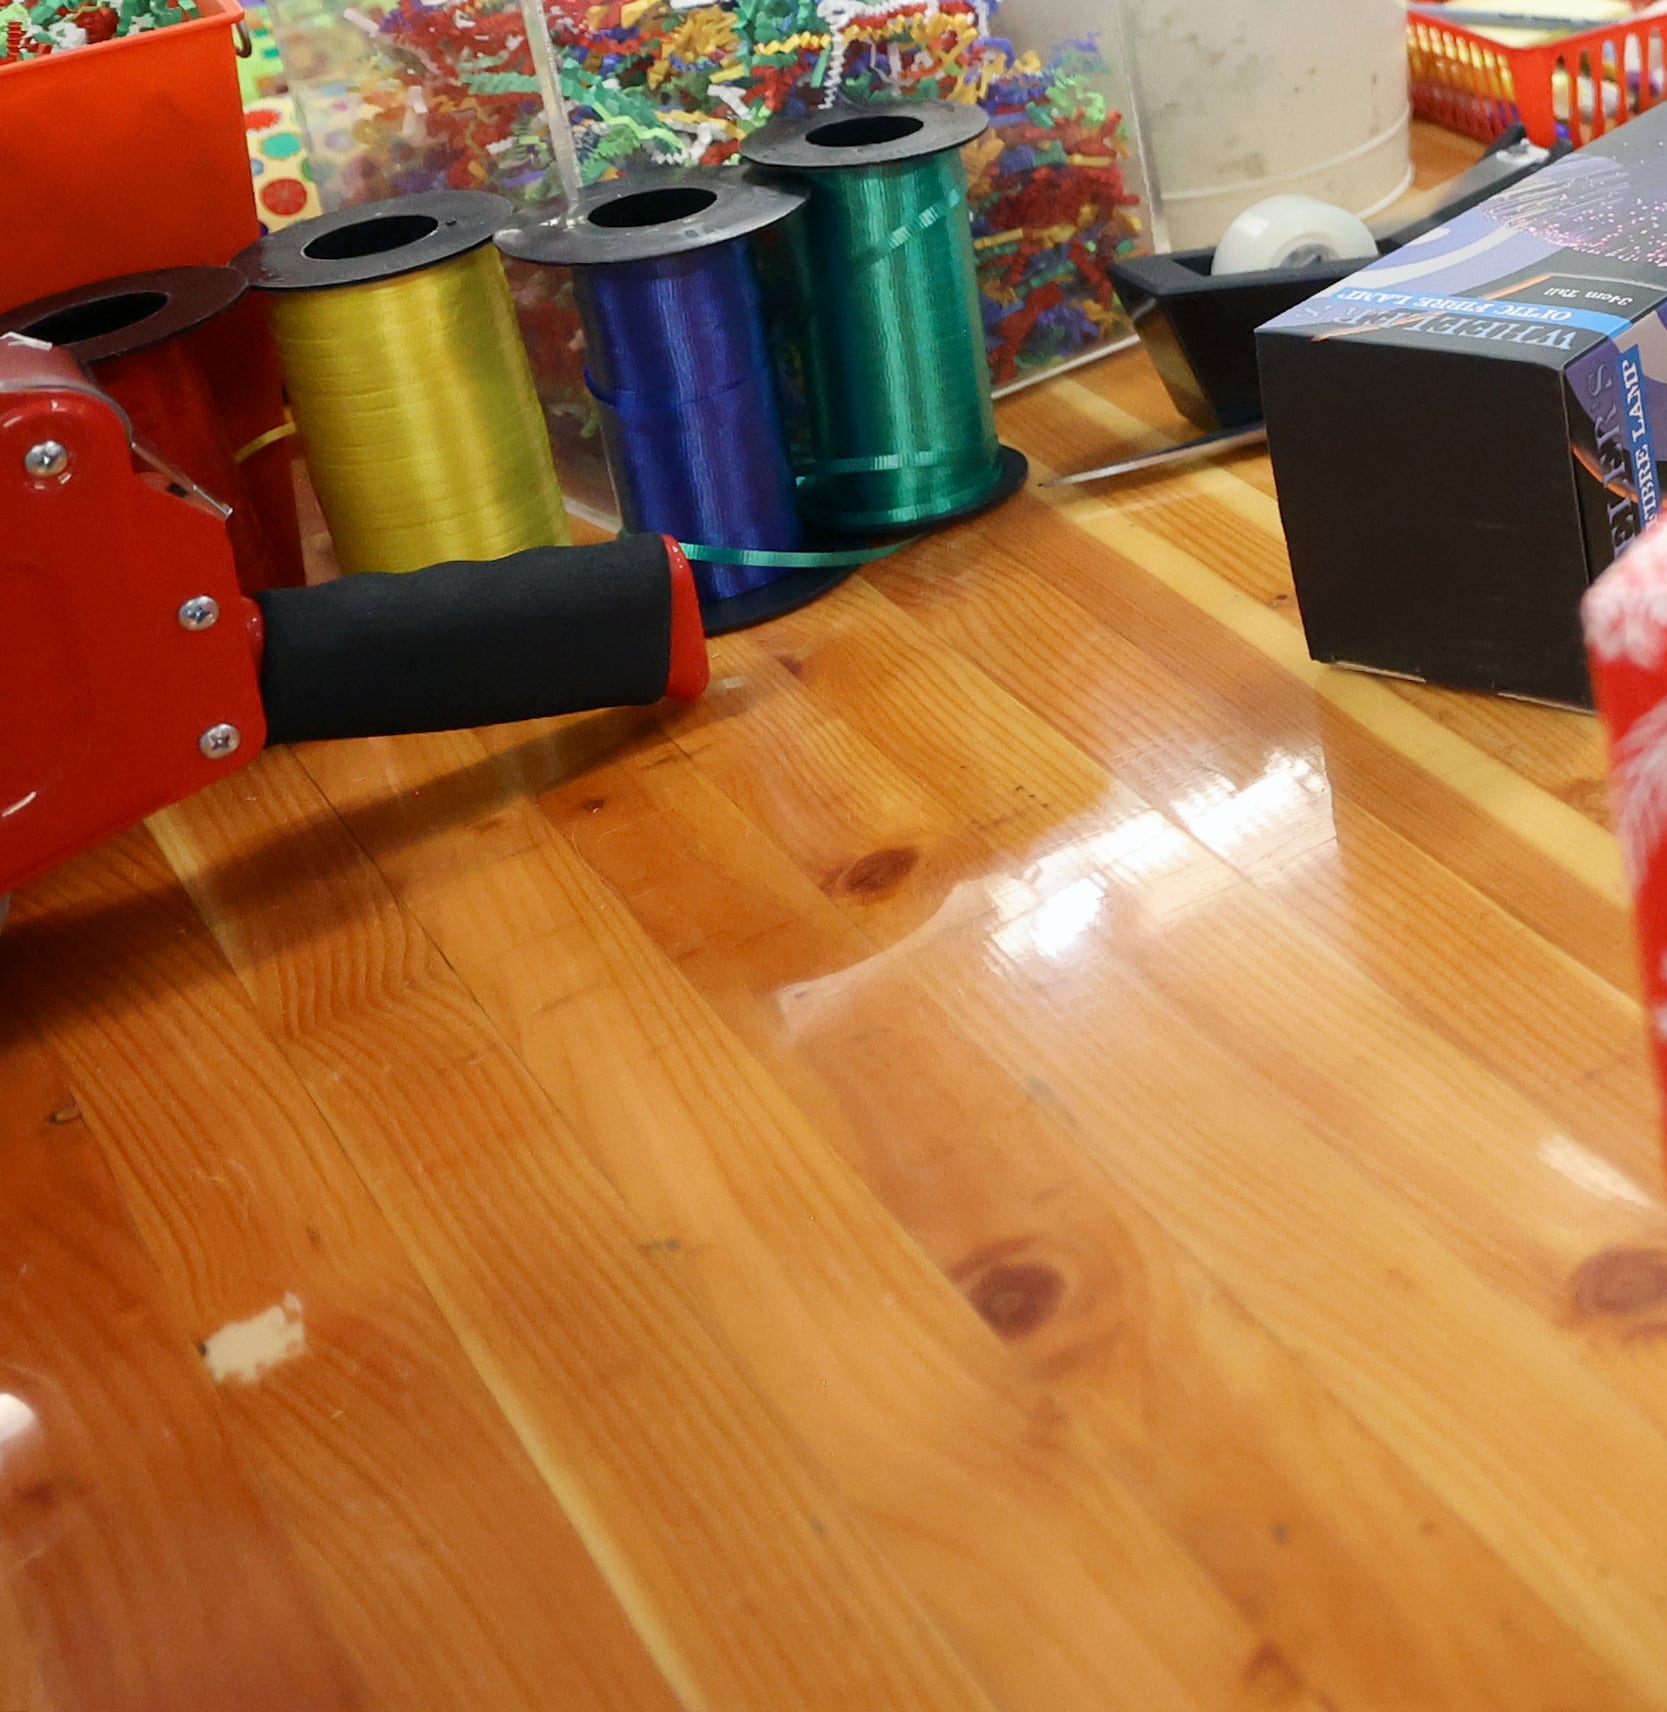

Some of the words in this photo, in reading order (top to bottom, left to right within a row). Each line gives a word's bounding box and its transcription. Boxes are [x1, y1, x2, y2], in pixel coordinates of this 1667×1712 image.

[1336, 289, 1414, 305] LAMP
[1543, 287, 1579, 300] Tall
[1584, 290, 1634, 307] 34cm
[1413, 296, 1494, 313] FIBRE
[1495, 305, 1573, 321] OPTIC
[1296, 304, 1578, 351] WHEELER'S
[1621, 359, 1647, 443] LAMP
[1587, 363, 1639, 561] ELER'S
